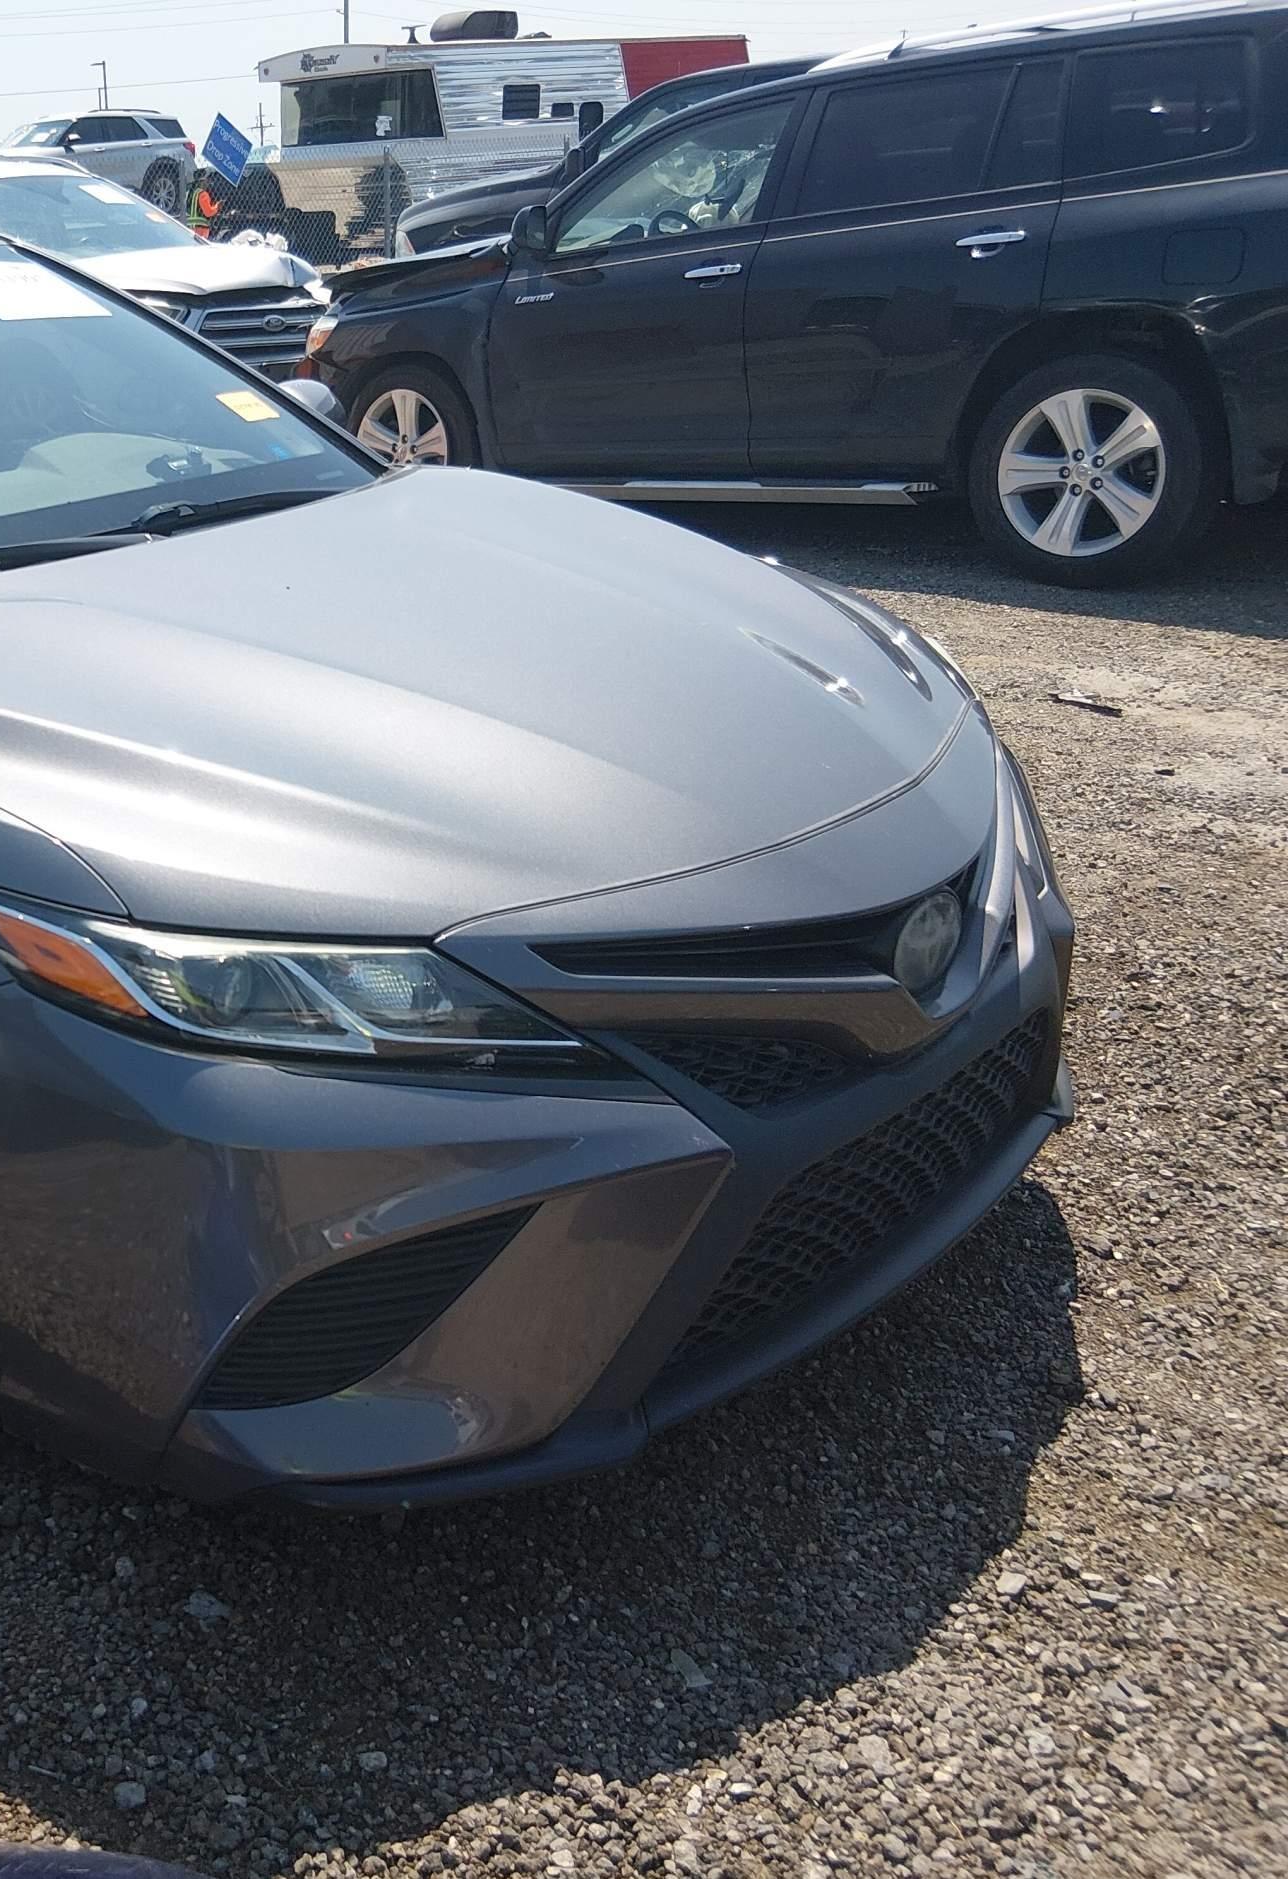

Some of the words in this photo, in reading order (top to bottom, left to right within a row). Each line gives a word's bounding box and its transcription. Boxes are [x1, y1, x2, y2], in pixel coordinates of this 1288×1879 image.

[213, 119, 249, 158] Progressive
[207, 140, 224, 160] Drop
[223, 154, 241, 176] Zone
